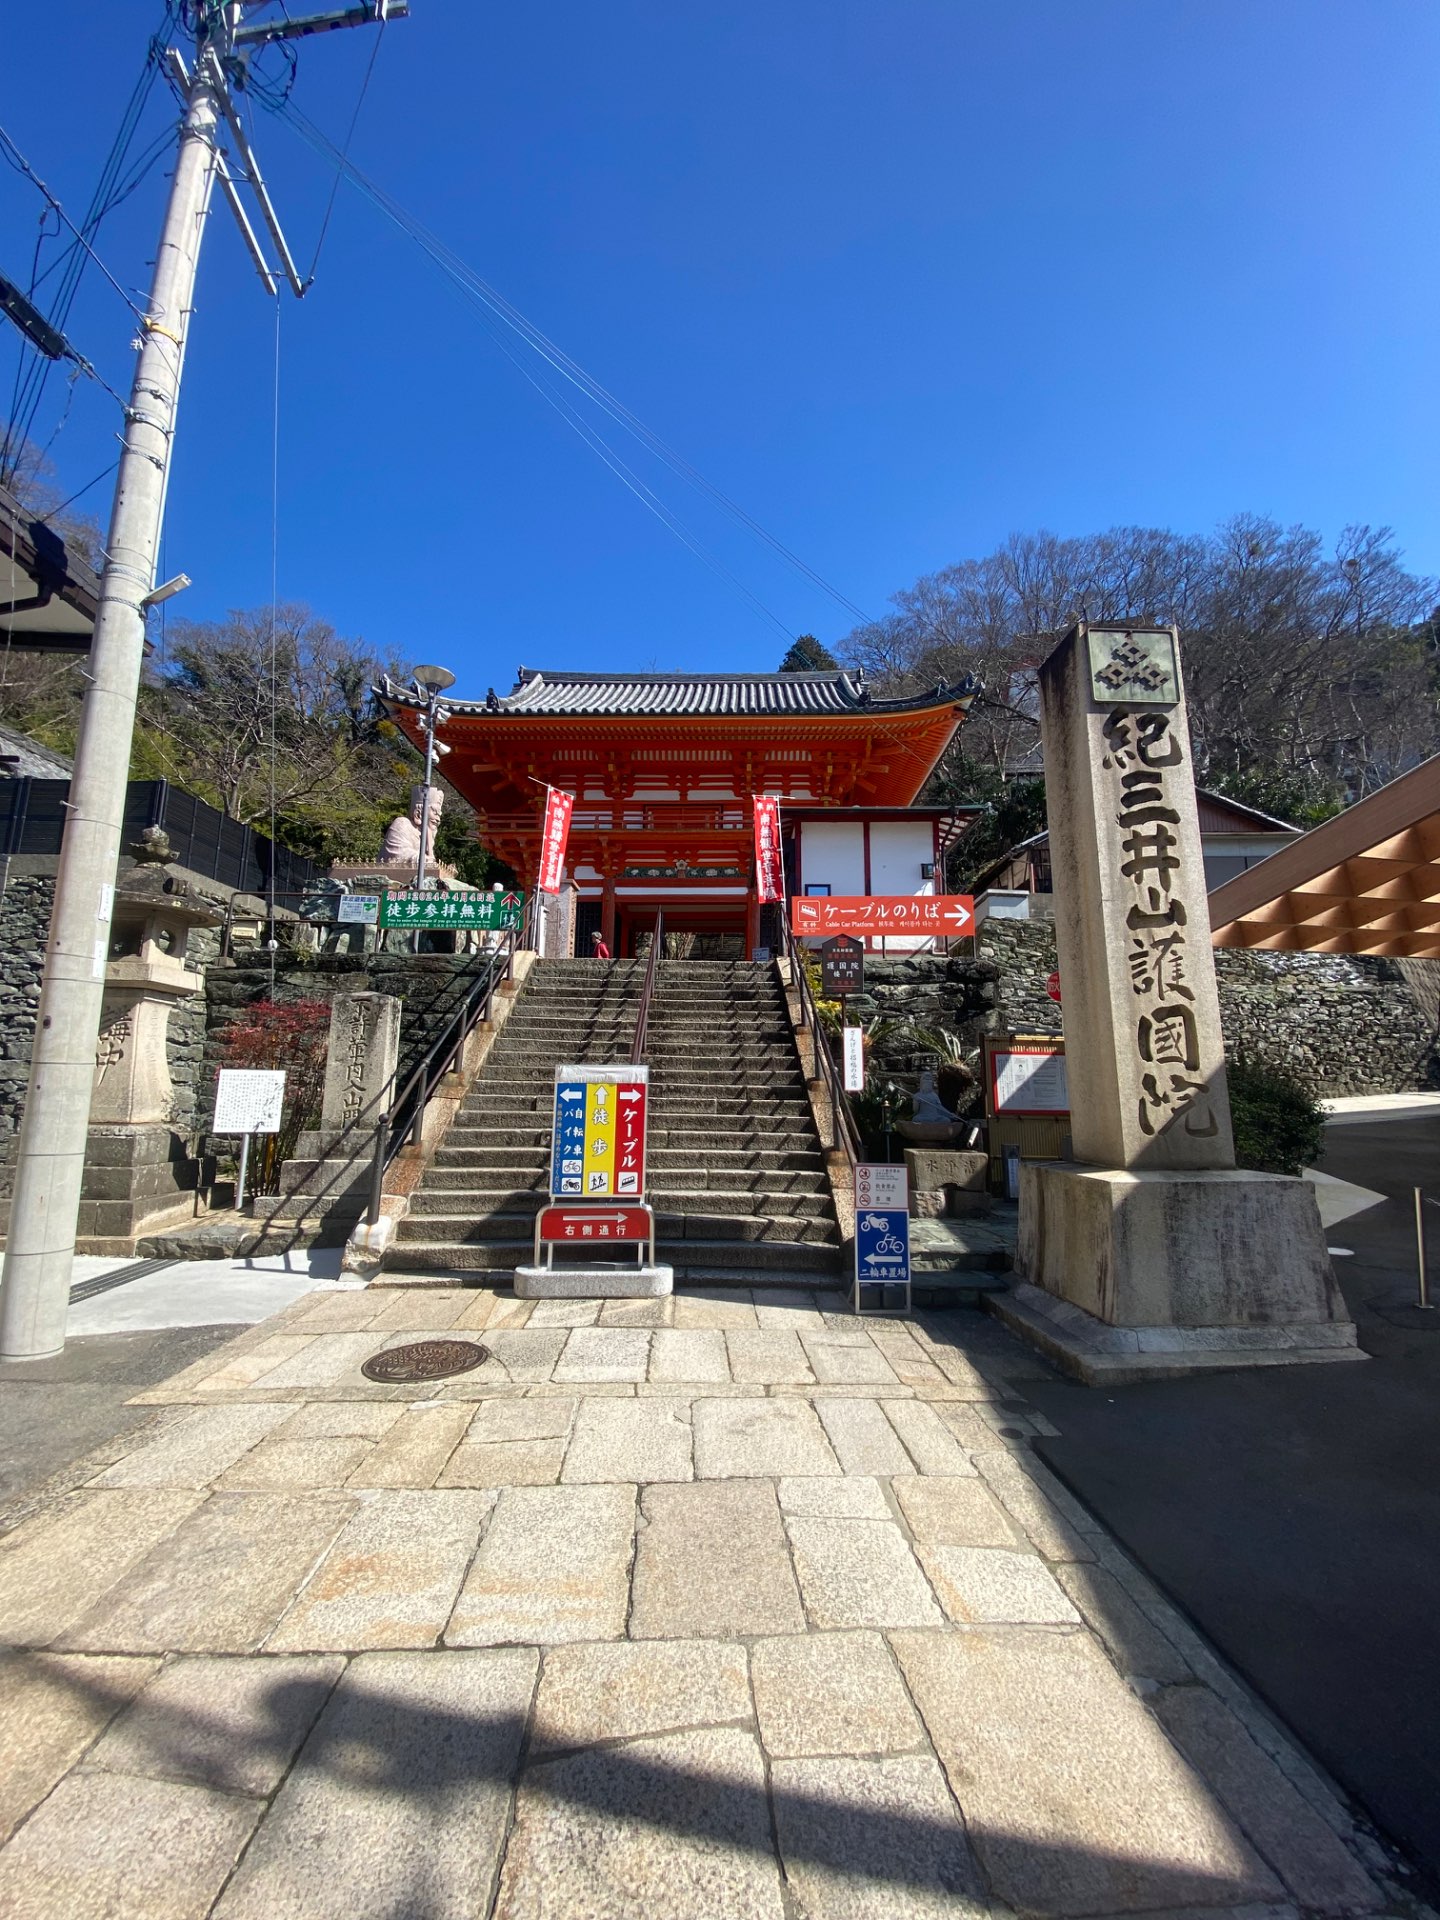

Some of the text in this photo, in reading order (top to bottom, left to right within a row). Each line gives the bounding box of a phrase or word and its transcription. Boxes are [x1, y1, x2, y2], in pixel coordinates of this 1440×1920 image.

[385, 901, 495, 919] 徒歩参拝無料
[824, 901, 942, 920] ケーブルのりば
[1102, 705, 1219, 1139] 紀三井山護國院
[563, 1108, 574, 1156] バイク
[572, 1107, 584, 1156] 自転車
[591, 1107, 610, 1158] 徒歩
[620, 1107, 639, 1169] ケーブル
[564, 1224, 627, 1236] 右側通行
[859, 1266, 907, 1278] 二輪車置場
